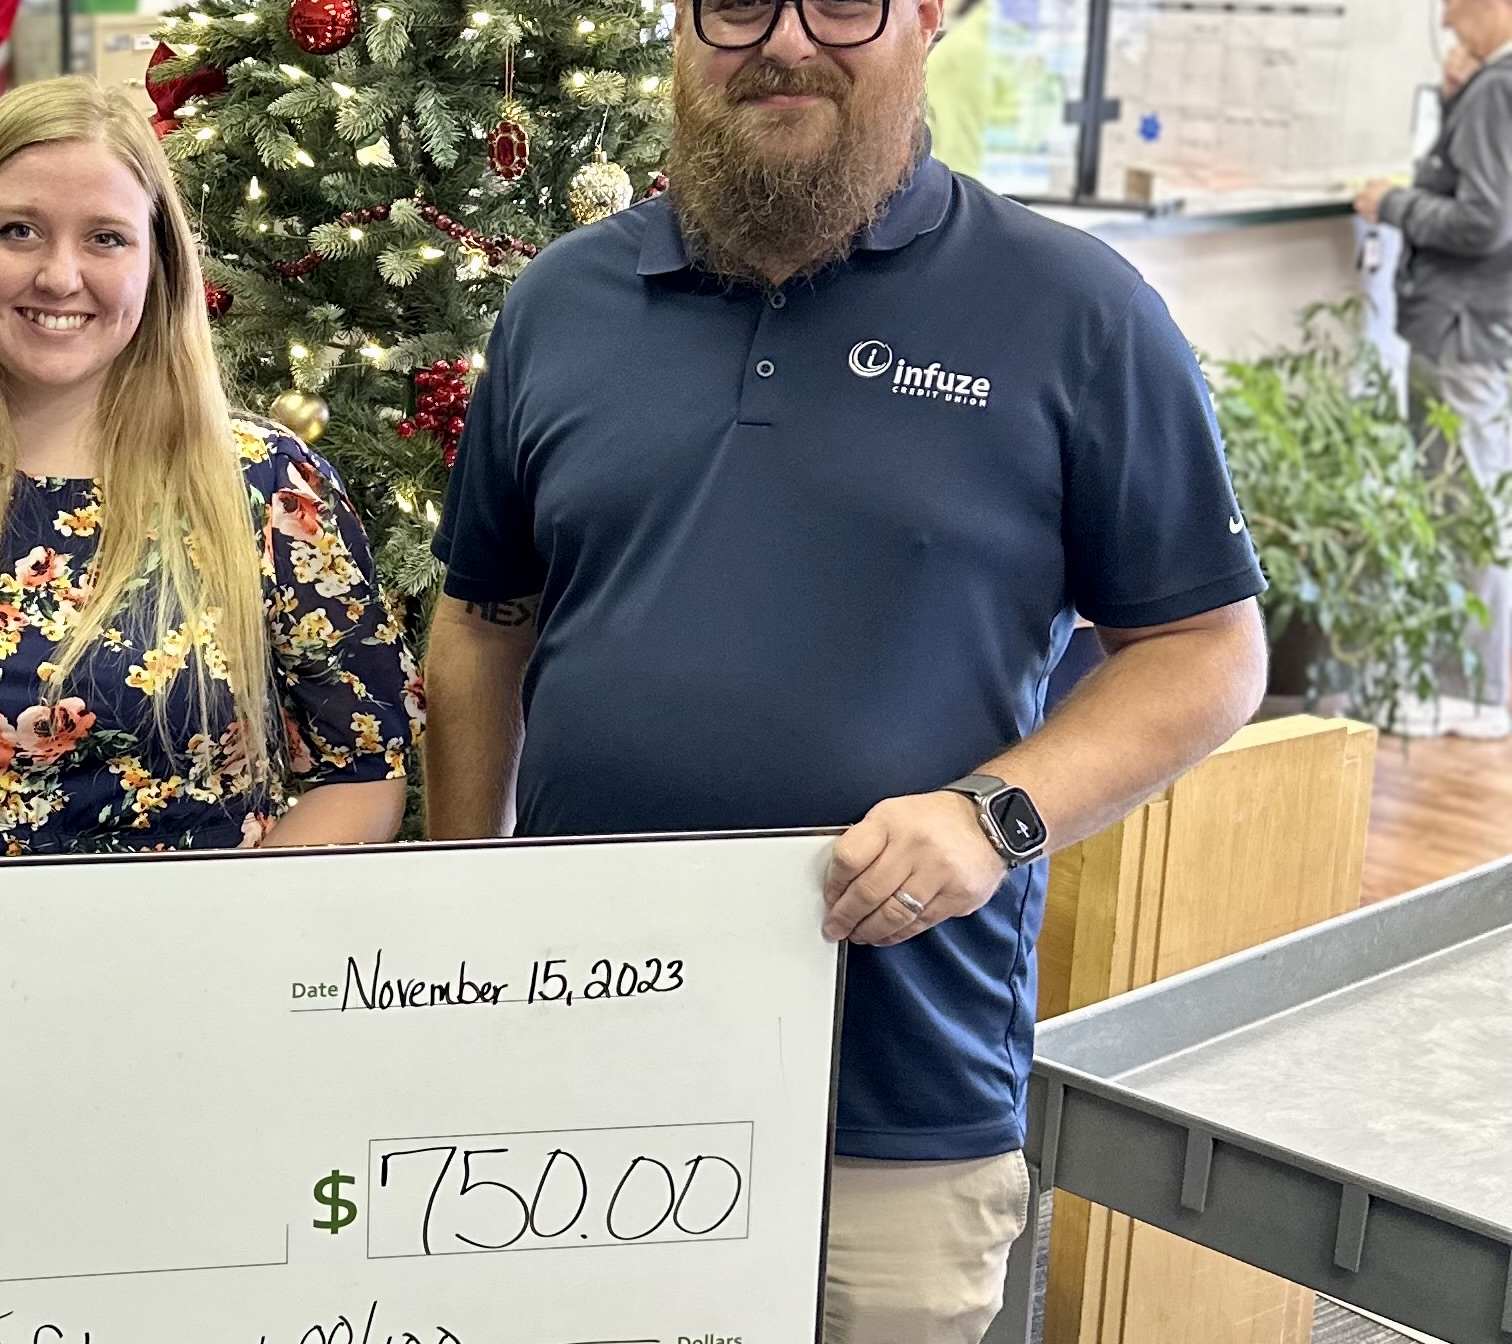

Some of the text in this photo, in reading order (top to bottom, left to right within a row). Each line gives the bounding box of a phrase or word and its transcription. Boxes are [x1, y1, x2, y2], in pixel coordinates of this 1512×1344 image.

[891, 385, 988, 408] CREDIT UNION
[892, 358, 991, 397] infuze
[291, 981, 339, 1000] Date
[340, 948, 509, 1012] November
[312, 1169, 357, 1235] $
[380, 1145, 743, 1256] 750.00
